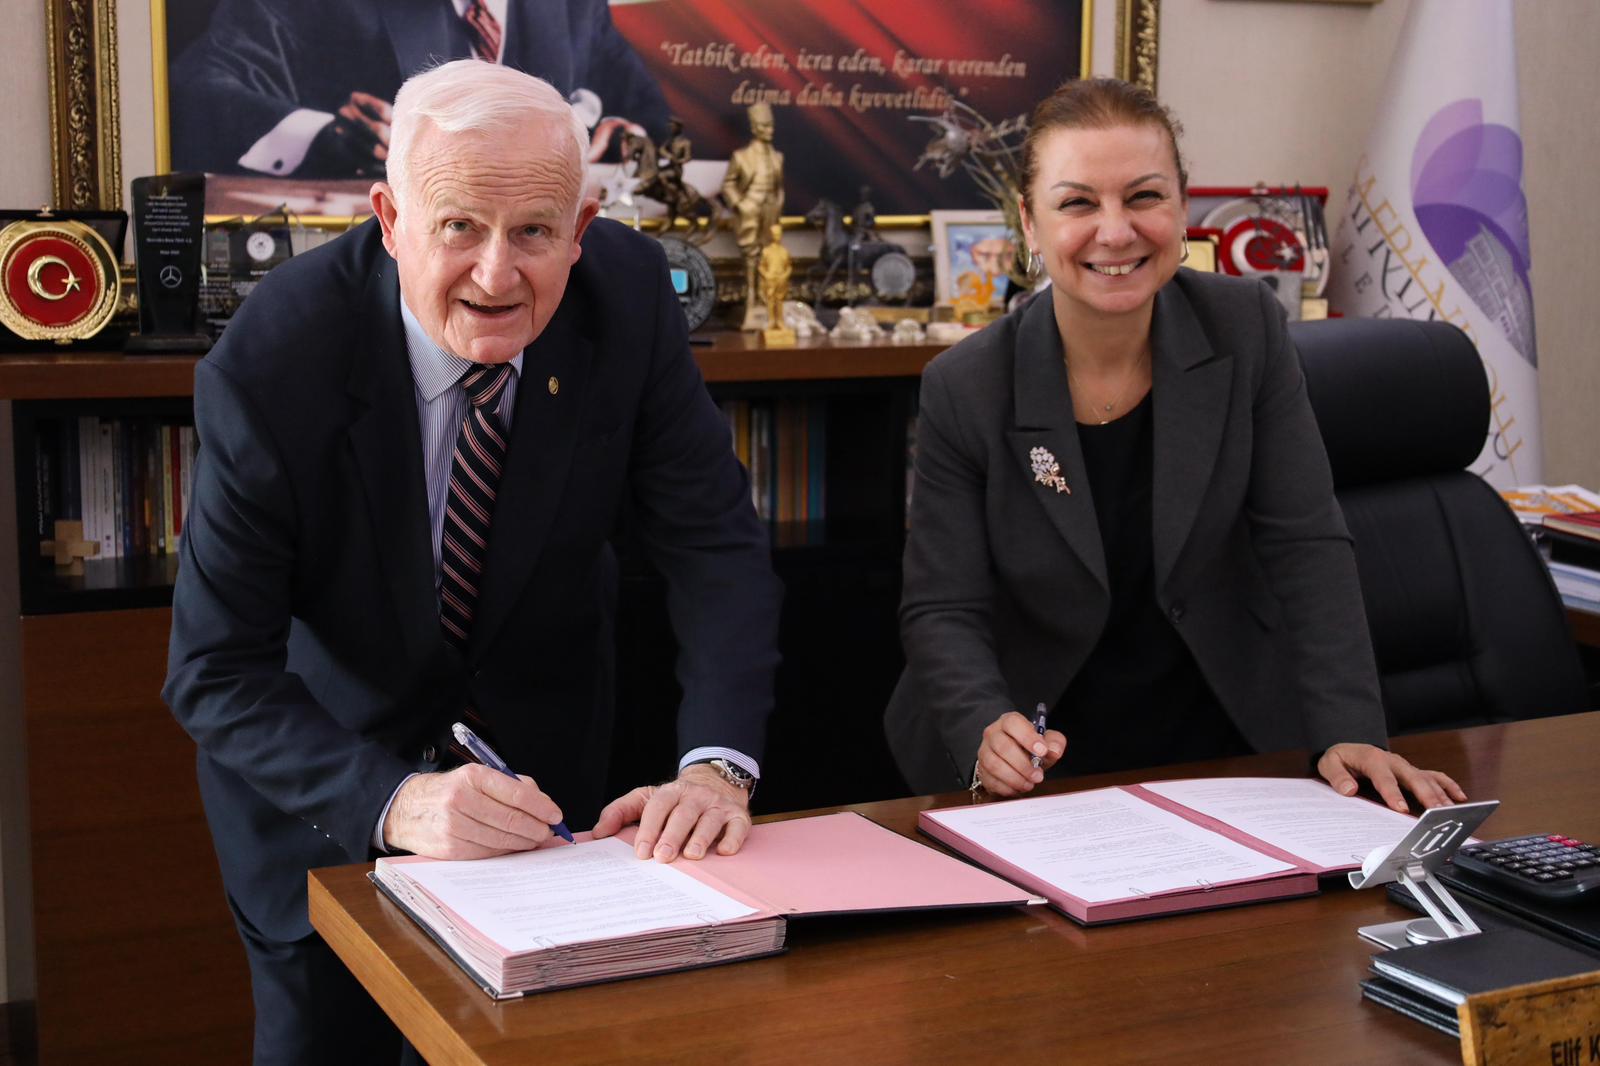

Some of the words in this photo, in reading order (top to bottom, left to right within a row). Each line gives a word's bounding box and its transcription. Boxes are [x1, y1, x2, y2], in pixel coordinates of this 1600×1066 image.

[740, 44, 790, 72] eden,
[797, 47, 833, 71] icra
[838, 48, 886, 76] eden,
[892, 49, 944, 78] karar
[947, 53, 1027, 77] verenden
[796, 82, 844, 106] daha
[1551, 1036, 1582, 1066] Elif
